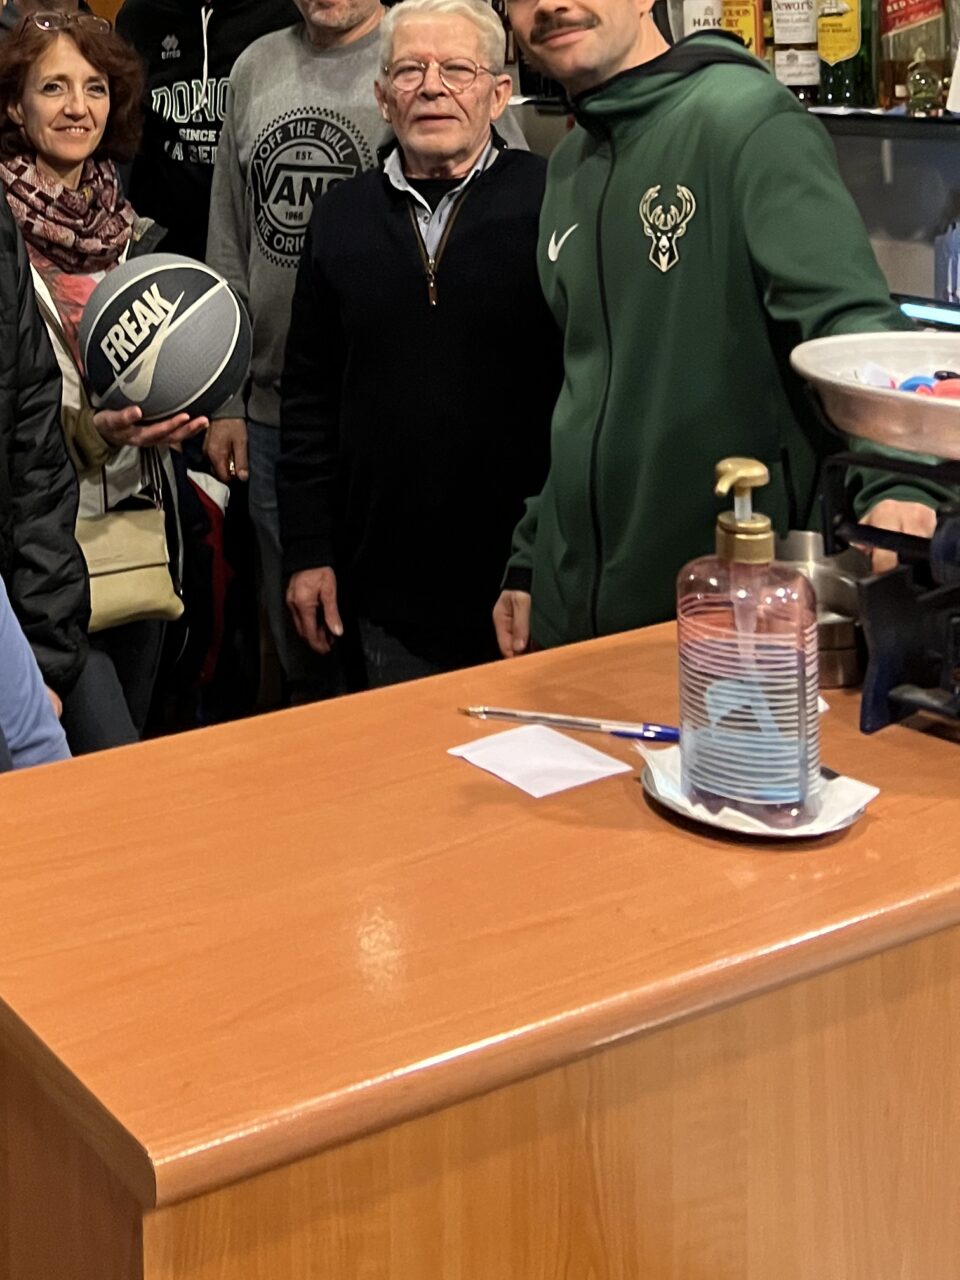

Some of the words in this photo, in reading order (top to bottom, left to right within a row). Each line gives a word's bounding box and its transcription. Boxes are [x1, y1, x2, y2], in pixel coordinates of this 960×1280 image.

[886, 0, 906, 13] RED
[179, 128, 217, 142] SINCE
[259, 128, 284, 159] OFF
[288, 120, 317, 138] THE
[321, 124, 353, 162] WALL
[295, 151, 313, 161] EST.
[257, 208, 274, 242] THE
[100, 282, 174, 372] FREAK
